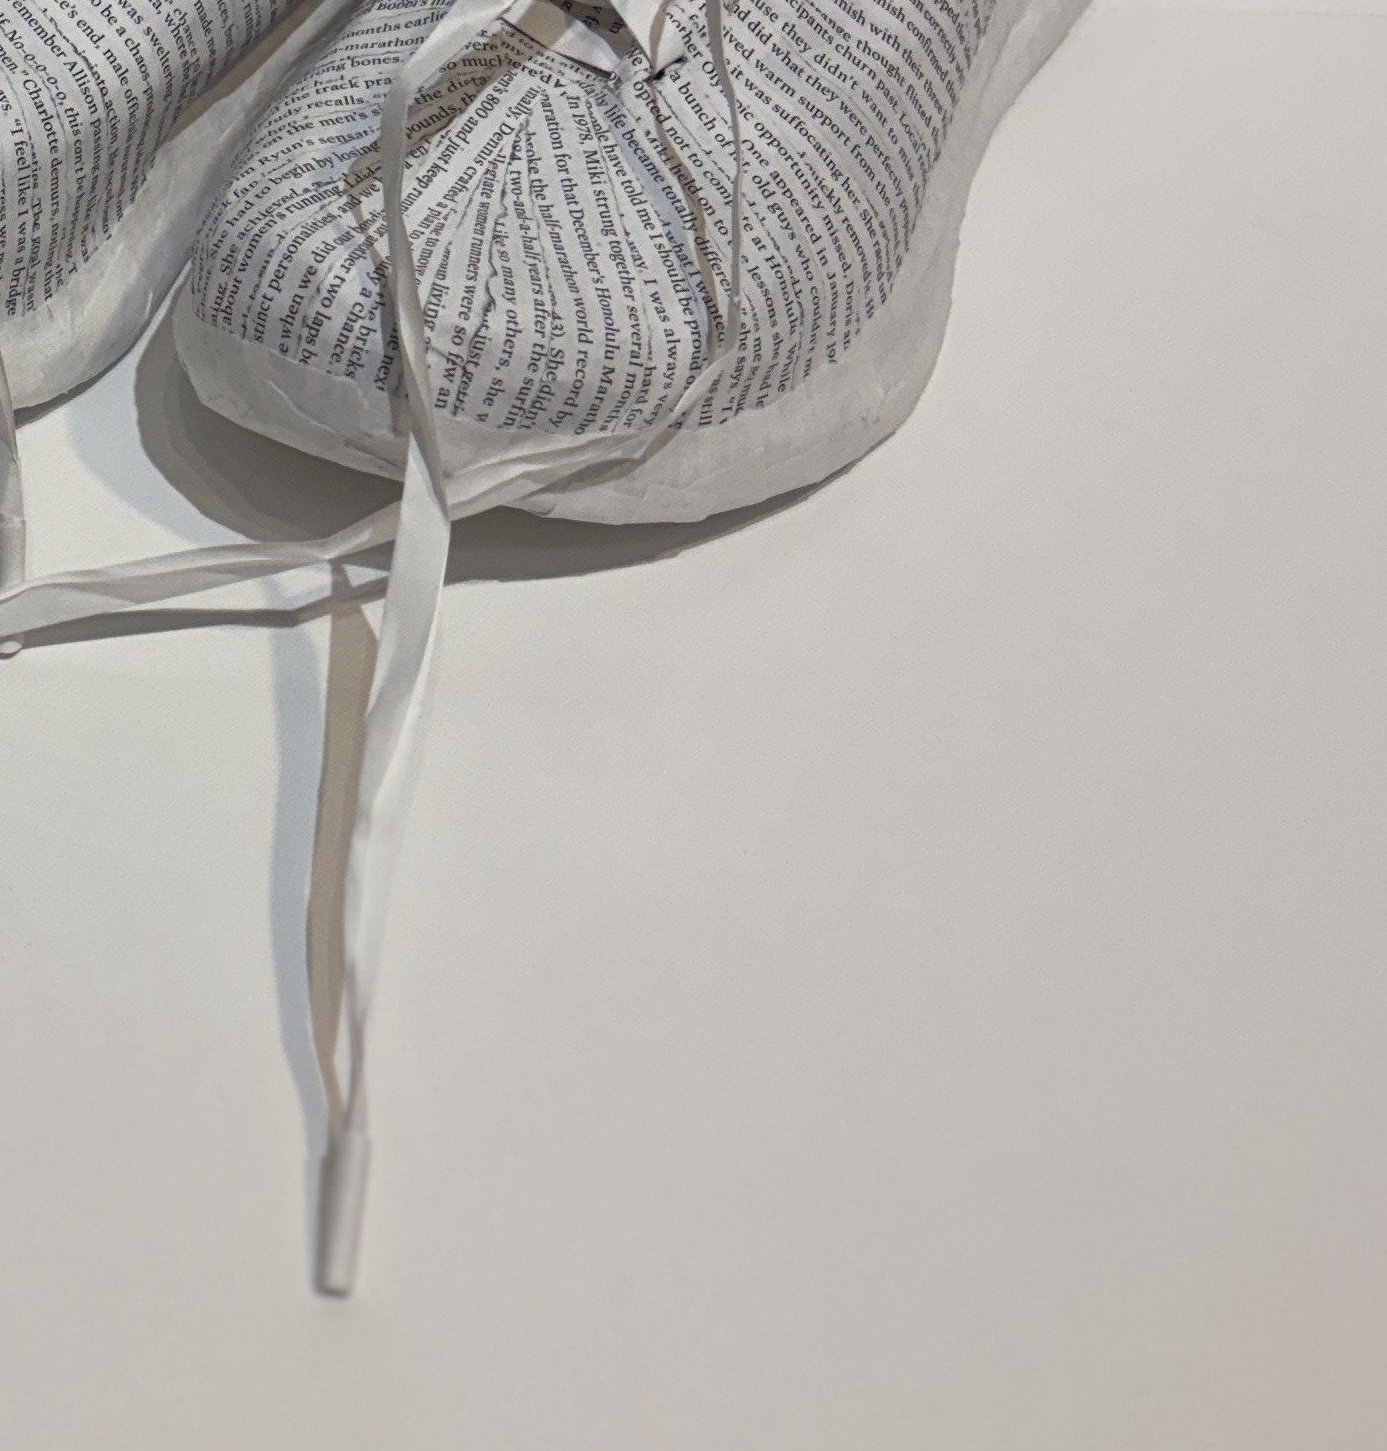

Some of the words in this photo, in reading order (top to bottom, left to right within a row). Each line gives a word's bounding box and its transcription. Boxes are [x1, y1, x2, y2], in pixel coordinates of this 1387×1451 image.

[194, 0, 213, 37] made
[77, 20, 104, 49] end,
[103, 49, 128, 86] male
[782, 22, 811, 53] they
[814, 54, 858, 90] didn't
[862, 90, 887, 127] want
[835, 44, 876, 80] churn
[23, 79, 58, 154] Charlotte
[63, 62, 97, 114] Allison
[772, 43, 804, 77] what
[806, 75, 839, 102] they
[840, 101, 867, 135] were
[572, 114, 593, 144] 1978,
[760, 63, 795, 97] warm
[798, 96, 850, 146] support
[850, 144, 875, 181] from
[772, 104, 843, 181] suffocating
[14, 141, 30, 171] feel
[269, 163, 316, 185] begin
[583, 150, 606, 184] Miki
[679, 83, 716, 131] bunch
[752, 175, 776, 199] old
[767, 203, 796, 240] guys
[754, 123, 824, 208] opportunity
[18, 175, 30, 205] like
[593, 190, 617, 236] strung
[663, 180, 700, 233] totally
[238, 209, 286, 272] women's
[466, 237, 483, 281] runners
[538, 204, 580, 293] half-marathon
[603, 144, 626, 177] have
[621, 180, 642, 206] told
[654, 243, 690, 293] should
[684, 320, 703, 371] proud
[5, 267, 26, 316] bridge
[279, 294, 304, 338] when
[311, 241, 337, 263] did
[502, 267, 516, 305] many
[569, 209, 603, 284] December's
[595, 287, 620, 360] Honolulu
[609, 241, 635, 300] together
[764, 255, 804, 336] Honolulu
[221, 277, 242, 323] about
[305, 311, 331, 346] laps
[321, 275, 346, 308] two
[459, 286, 475, 320] were
[534, 299, 551, 338] after
[574, 298, 593, 344] world
[499, 310, 522, 367] others,
[627, 305, 652, 367] several
[663, 329, 691, 389] always
[564, 350, 588, 407] record
